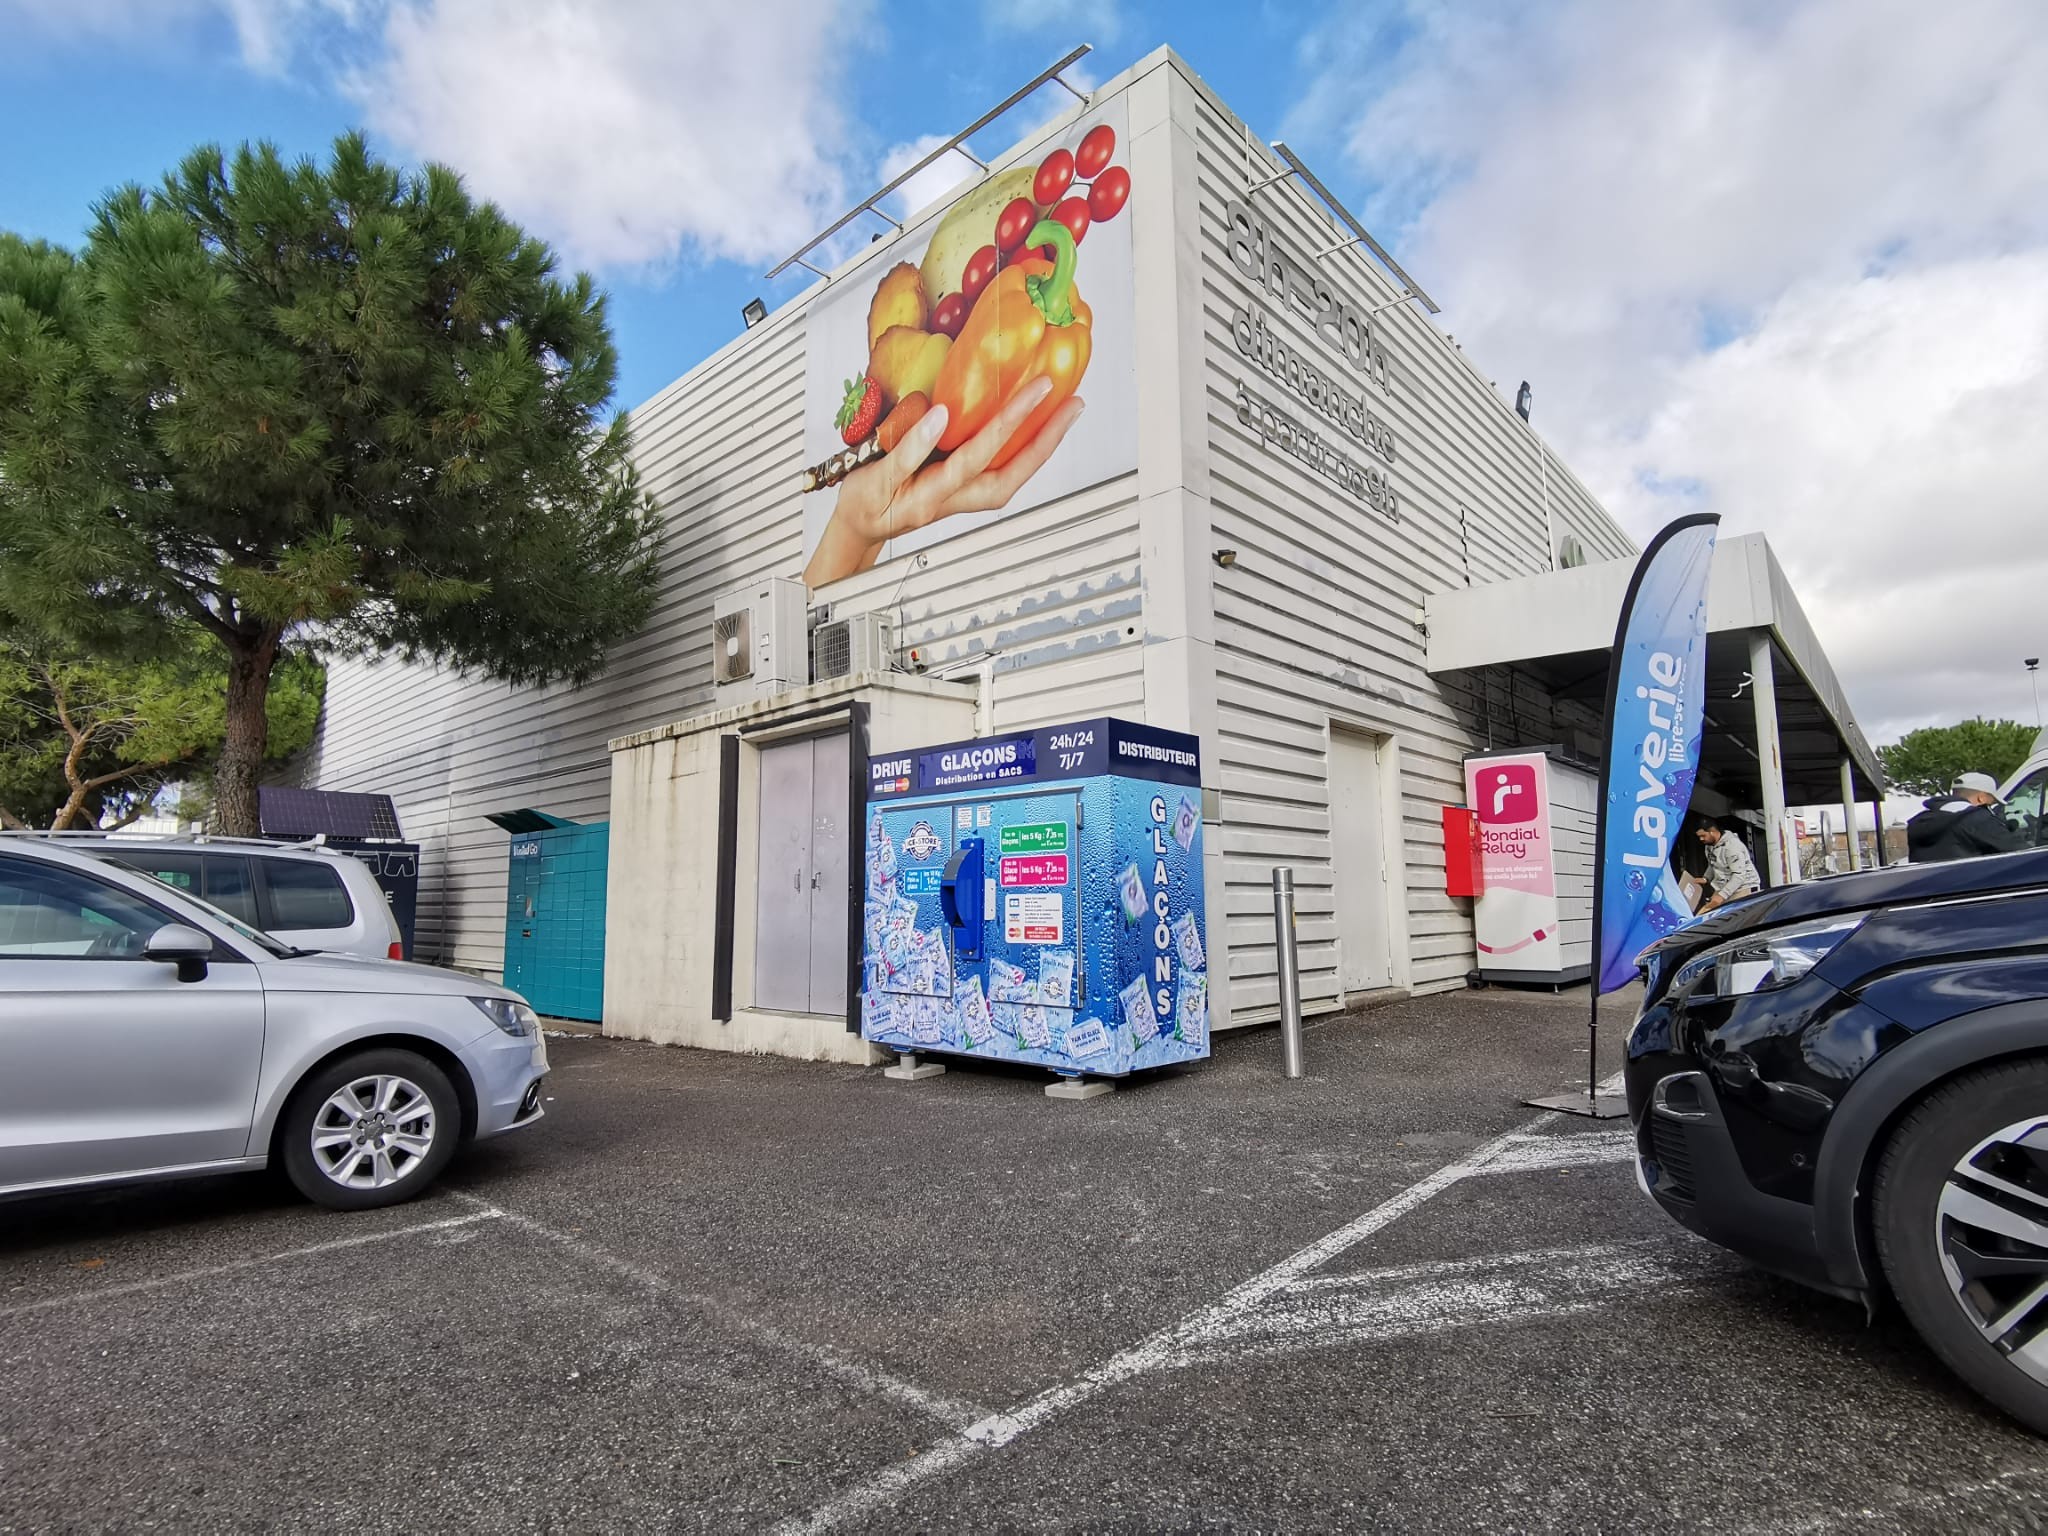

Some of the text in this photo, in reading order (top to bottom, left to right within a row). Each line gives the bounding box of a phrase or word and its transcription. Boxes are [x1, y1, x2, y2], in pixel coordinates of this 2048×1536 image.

[1232, 302, 1397, 463] dimanche
[1236, 377, 1251, 428] à
[1260, 405, 1328, 475] partir
[1050, 730, 1094, 750] 24h/24
[941, 744, 1017, 772] GLAÇONS
[1059, 751, 1084, 770] 7j/7
[1118, 740, 1197, 767] DISTRIBUTEUR
[1623, 651, 1682, 869] Laverie
[872, 758, 912, 779] DRIVE
[935, 773, 983, 786] Distribution
[999, 766, 1022, 778] SACS
[1480, 828, 1540, 842] Mondial
[1480, 842, 1526, 859] Relay
[1151, 797, 1171, 1016] GLAÇONS
